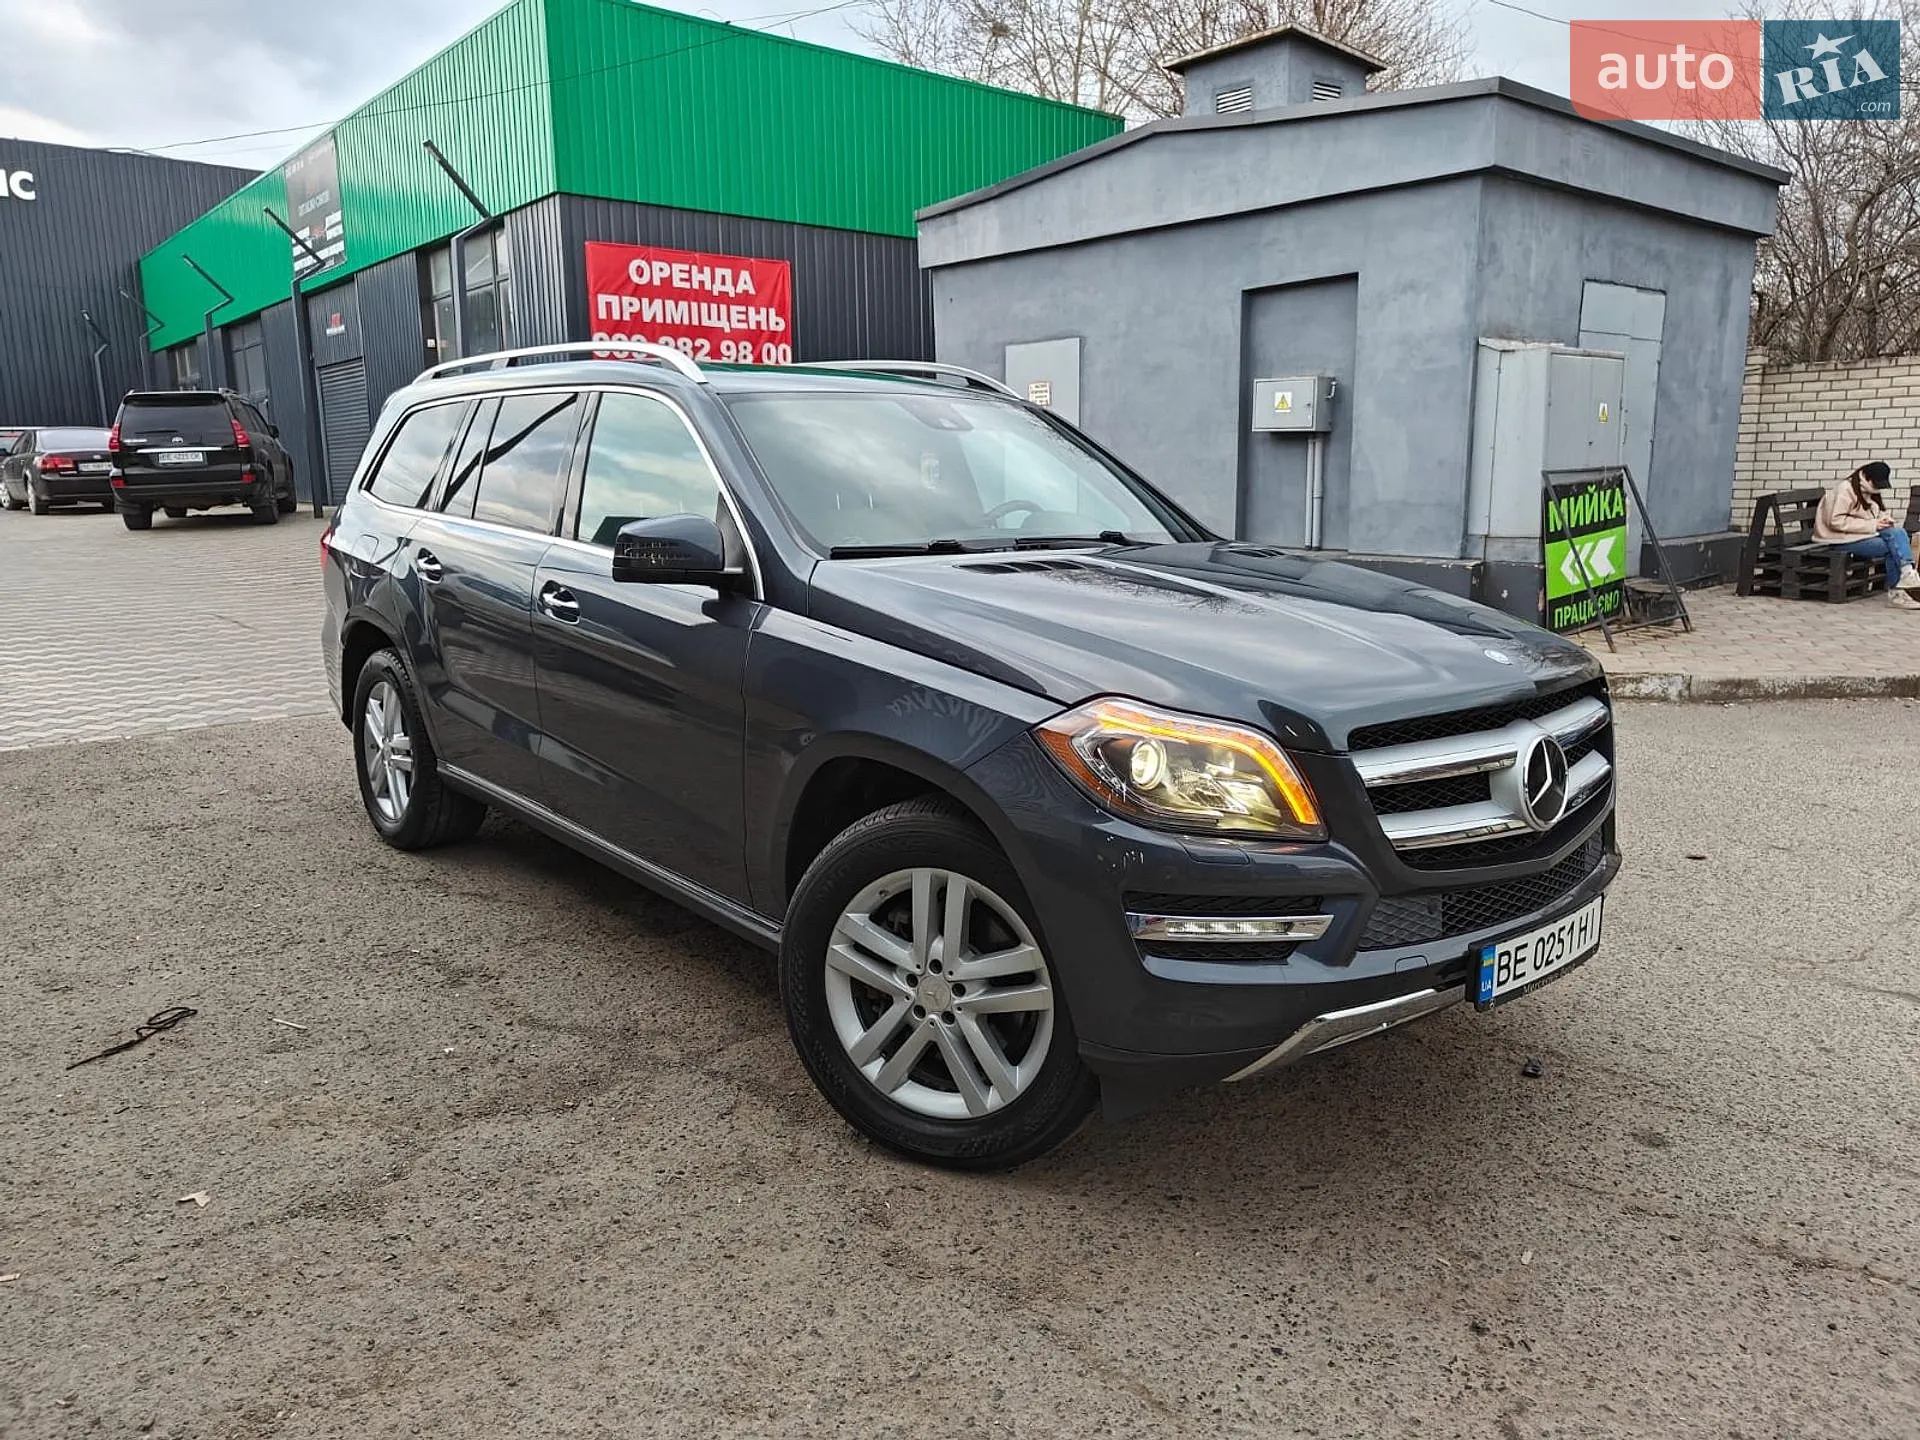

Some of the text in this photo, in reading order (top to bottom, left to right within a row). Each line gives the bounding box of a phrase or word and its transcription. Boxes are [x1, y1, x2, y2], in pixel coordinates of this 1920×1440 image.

[628, 258, 756, 298] ОРЕНДА
[597, 293, 786, 333] ПРИМІЩЕНЬ
[761, 342, 793, 365] 00
[1548, 484, 1625, 533] МИЙКА
[1497, 942, 1529, 988] BE
